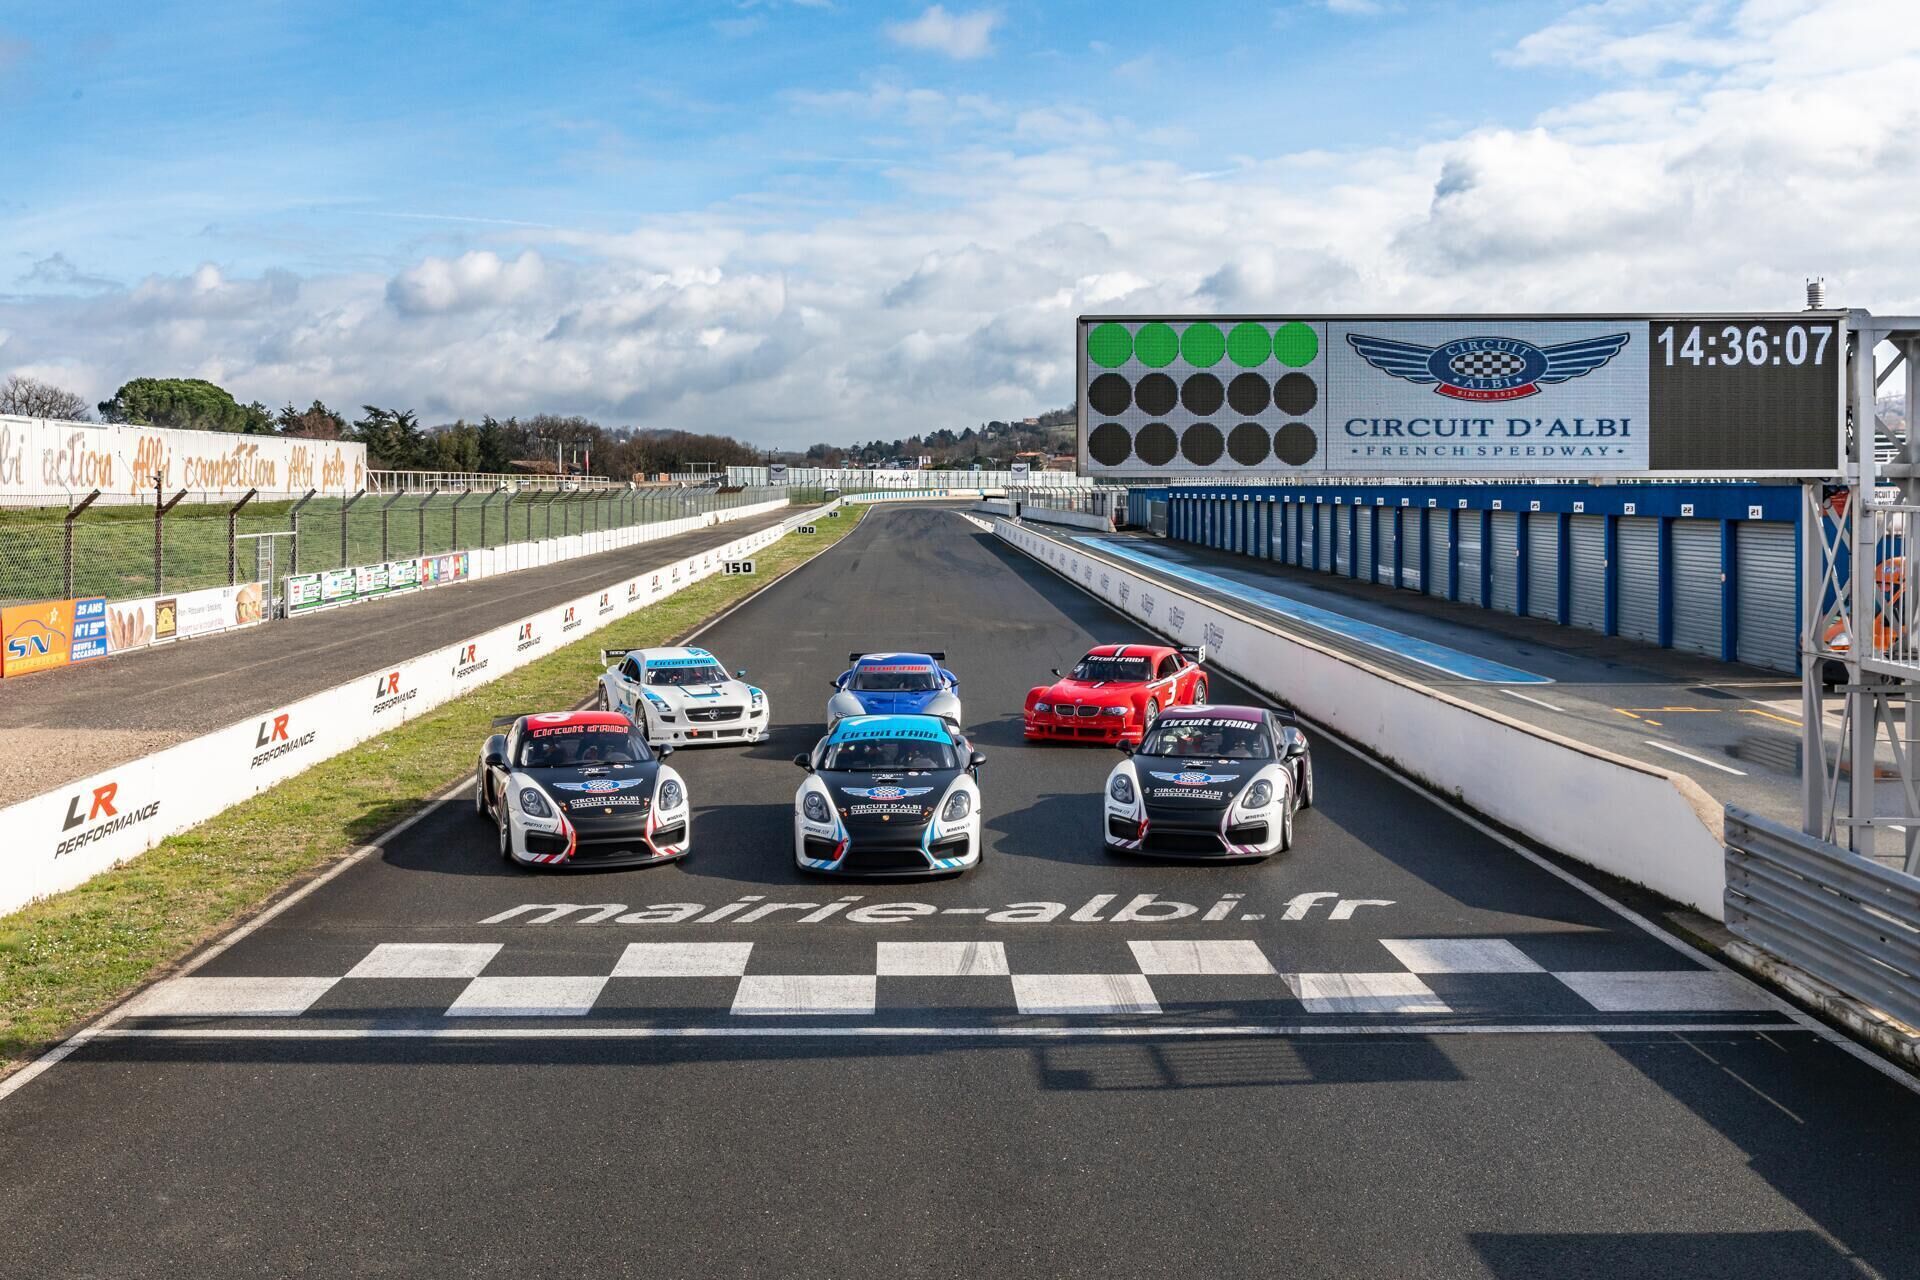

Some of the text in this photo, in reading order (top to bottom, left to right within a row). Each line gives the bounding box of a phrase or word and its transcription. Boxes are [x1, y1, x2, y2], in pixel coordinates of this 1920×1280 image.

[1446, 340, 1531, 356] CIRCUIT
[1658, 326, 1833, 366] 14:36:07
[1464, 379, 1512, 389] ALBI
[1345, 418, 1494, 437] CIRCUIT
[1367, 446, 1610, 456] FRENCH SPEEDWAY
[43, 431, 114, 488] action
[131, 436, 173, 497] Albi
[1575, 503, 1583, 511] 24
[1626, 505, 1634, 513] 23
[1683, 506, 1692, 514] 22
[1750, 508, 1760, 516] 21
[797, 526, 815, 534] 100
[725, 562, 752, 573] 150
[600, 593, 608, 607] LR
[77, 602, 103, 616] 25 ANS
[564, 606, 575, 622] LR
[518, 622, 532, 641] LR
[6, 633, 51, 660] SN
[459, 644, 476, 666] LR
[457, 658, 489, 680] PERFORMANCE
[376, 671, 400, 699] LR
[1165, 678, 1177, 706] 3
[372, 687, 418, 715] PERFORMANCE
[255, 713, 289, 748] LR
[1161, 718, 1212, 728] Circuit
[533, 725, 584, 738] Circuit
[841, 730, 891, 739] Circuit
[250, 730, 316, 770] PERFORMANCE
[62, 782, 118, 832] LR
[570, 796, 606, 805] CIRCUIT
[54, 800, 160, 860] PERFORMANCE
[477, 892, 1396, 924] mairie-albi.fr
